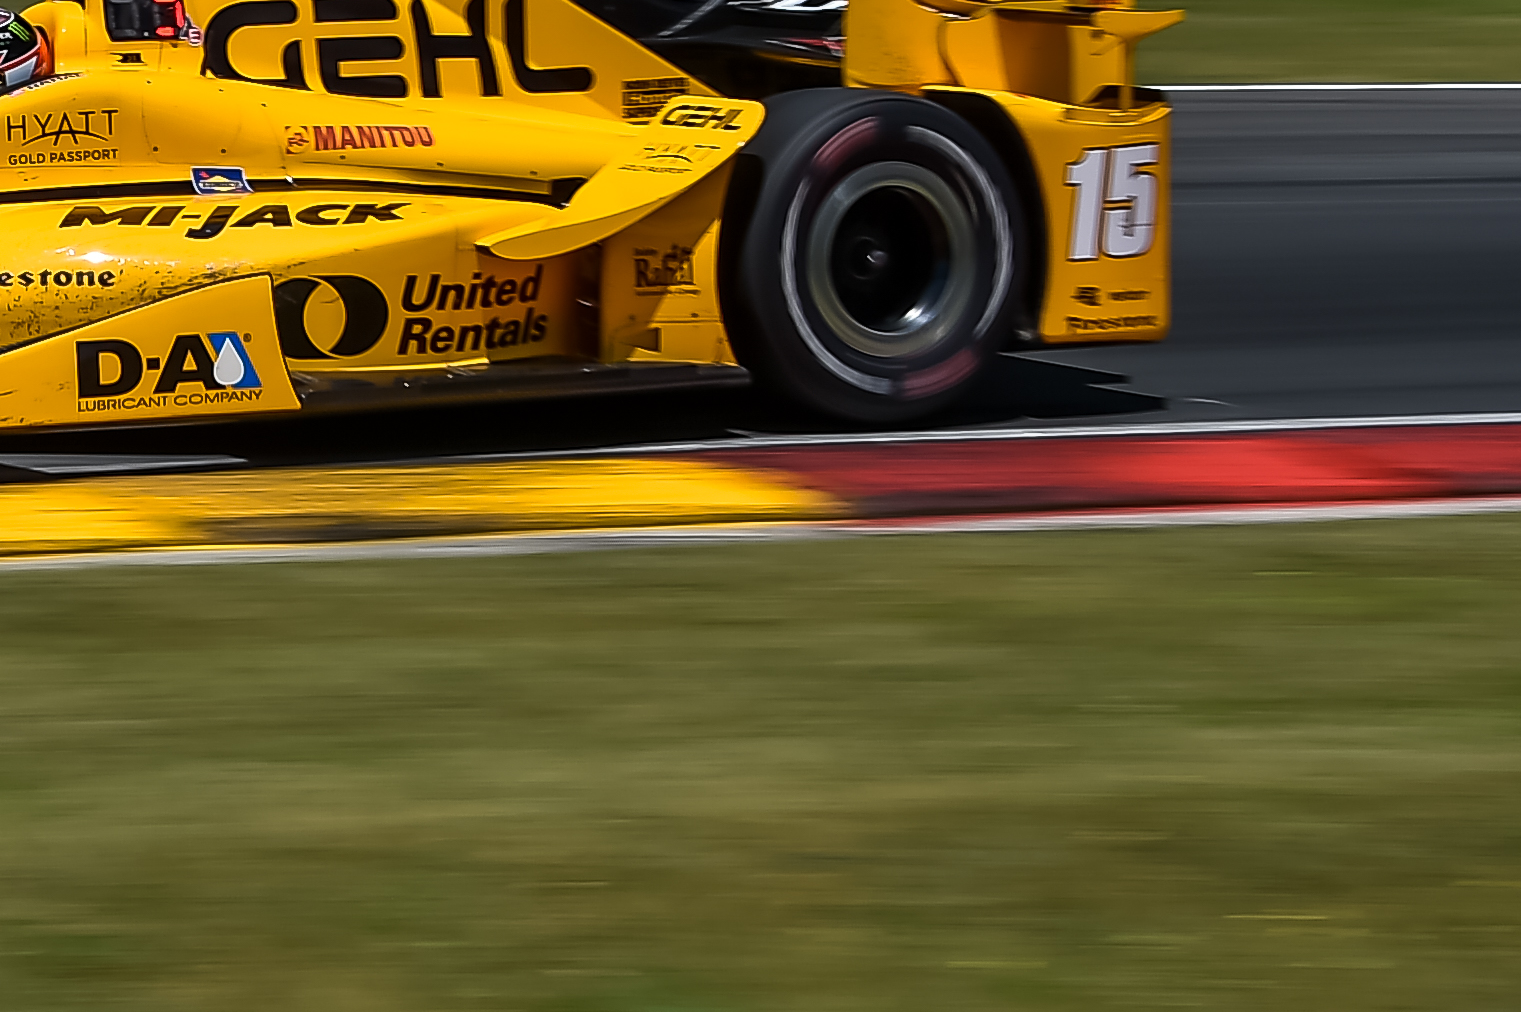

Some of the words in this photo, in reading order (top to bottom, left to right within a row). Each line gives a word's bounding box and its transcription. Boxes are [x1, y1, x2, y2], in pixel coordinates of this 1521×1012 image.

[7, 108, 120, 147] HYATT
[660, 104, 744, 130] GEHL
[8, 153, 46, 165] GOLD
[49, 148, 119, 164] PASSPORT
[314, 125, 436, 151] MANITOU
[59, 202, 412, 239] MI-JACK
[1066, 142, 1161, 262] 15
[400, 264, 543, 313] United
[397, 307, 549, 355] Rentals
[78, 396, 169, 413] LUBRICANT
[174, 389, 263, 407] COMPANY
